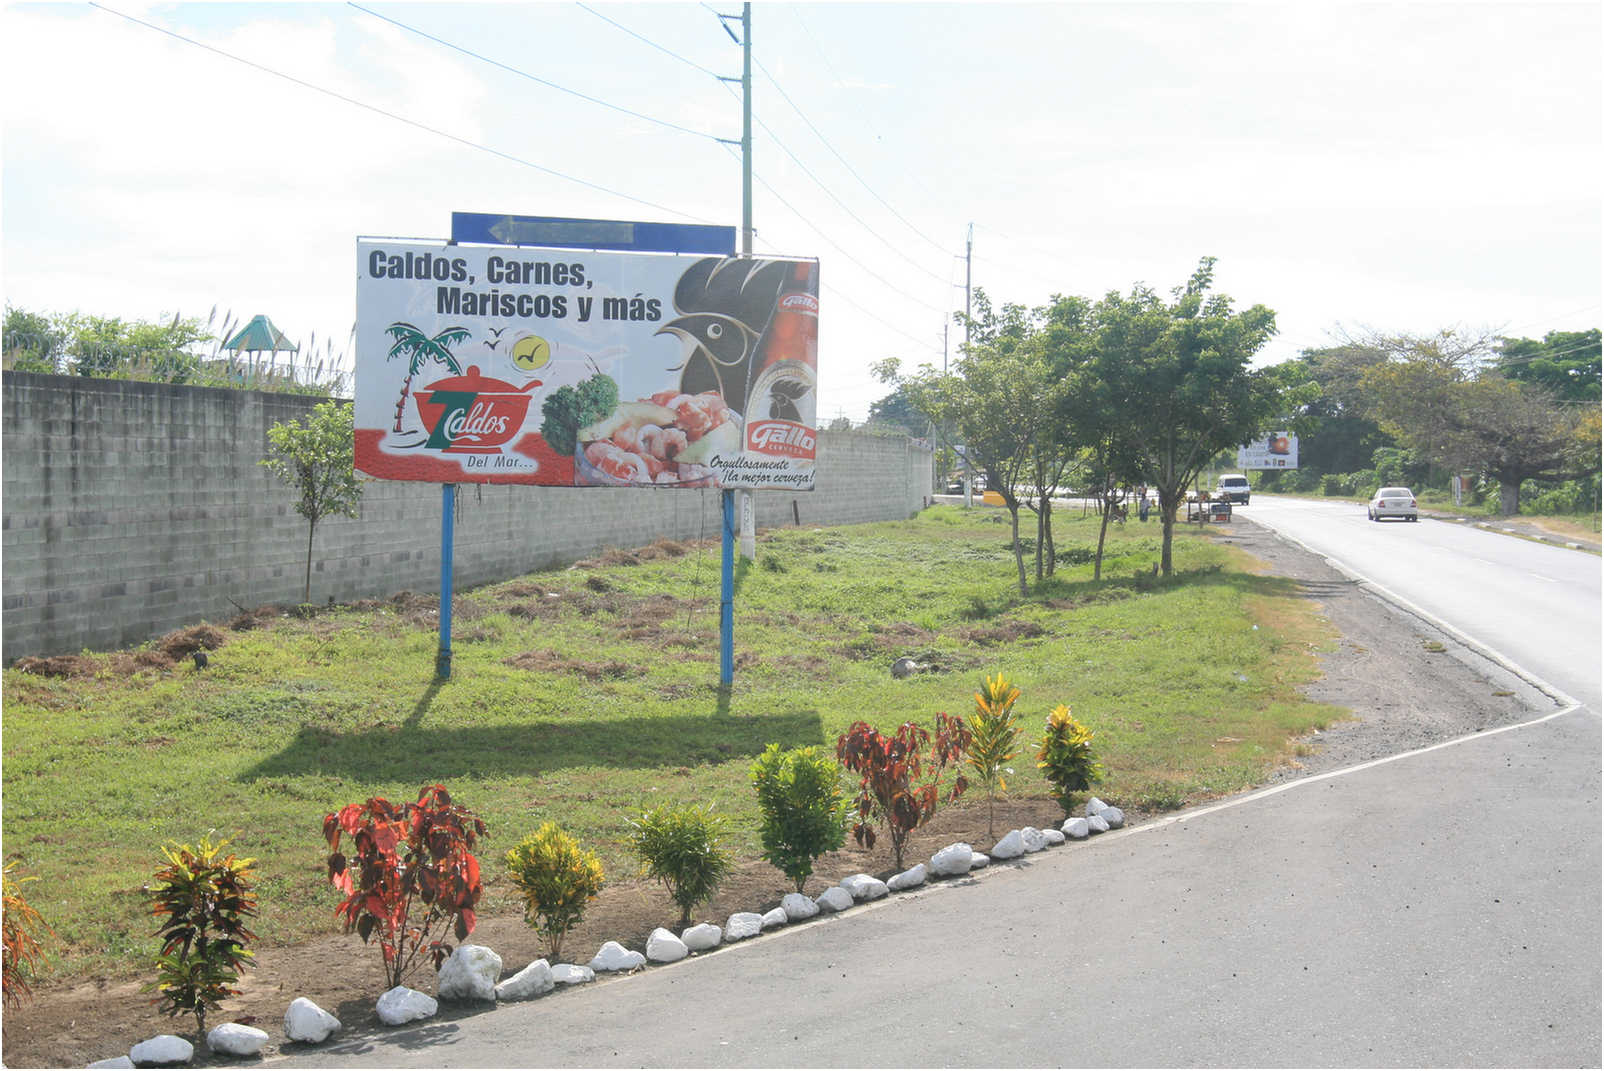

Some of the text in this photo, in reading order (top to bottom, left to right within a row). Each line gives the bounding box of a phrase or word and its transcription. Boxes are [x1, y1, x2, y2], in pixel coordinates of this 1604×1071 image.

[369, 250, 593, 289] Caldos, Carnes,
[437, 286, 662, 322] Mariscos y más
[783, 295, 818, 310] Gallo
[424, 391, 510, 449] 7 Caldos
[751, 423, 816, 451] Gallo
[467, 456, 487, 468] Del
[710, 454, 790, 473] Orgullosamente
[741, 471, 772, 486] mejor
[773, 469, 816, 487] cerveza!
